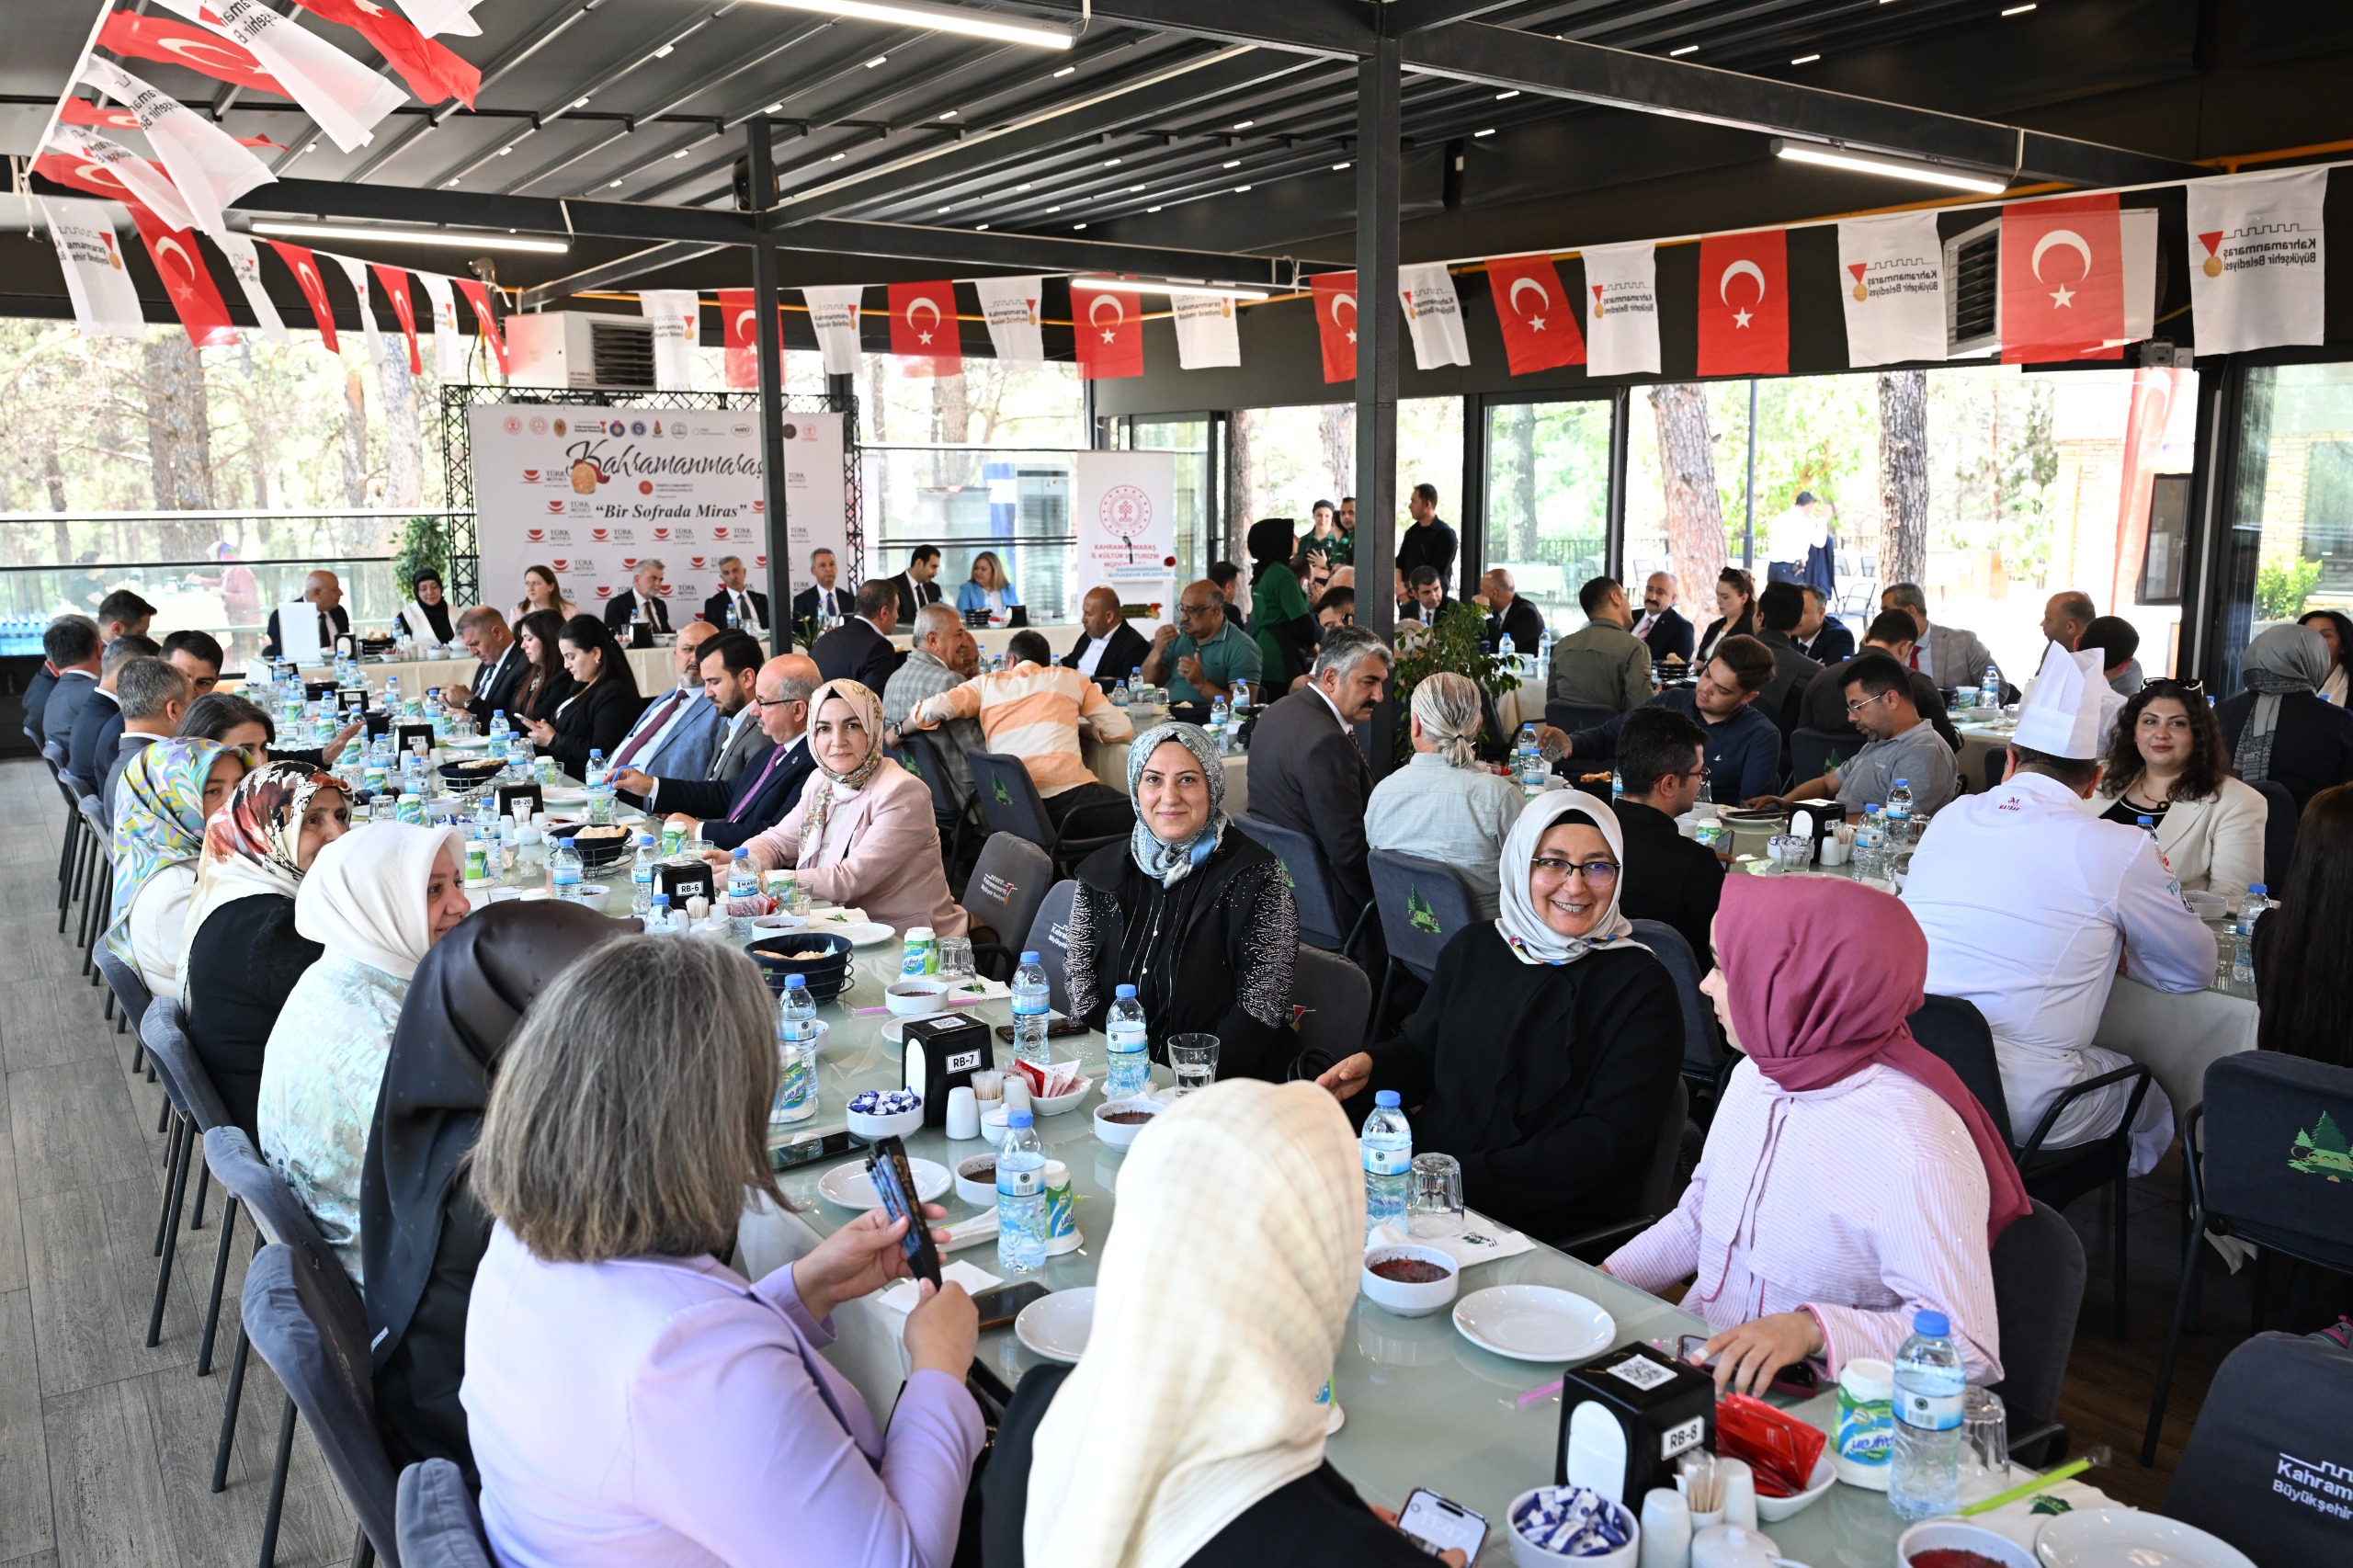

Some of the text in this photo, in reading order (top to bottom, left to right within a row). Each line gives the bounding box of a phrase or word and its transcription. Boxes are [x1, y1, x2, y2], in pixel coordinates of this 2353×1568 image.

[566, 439, 763, 479] Kahramanmaraş
[632, 505, 691, 521] Sofrada
[681, 883, 699, 893] RB-6
[953, 1054, 974, 1068] RB-7
[1670, 1424, 1698, 1449] RB-8
[2277, 1459, 2353, 1502] Kahram
[2272, 1479, 2353, 1521] Büyükşehir
